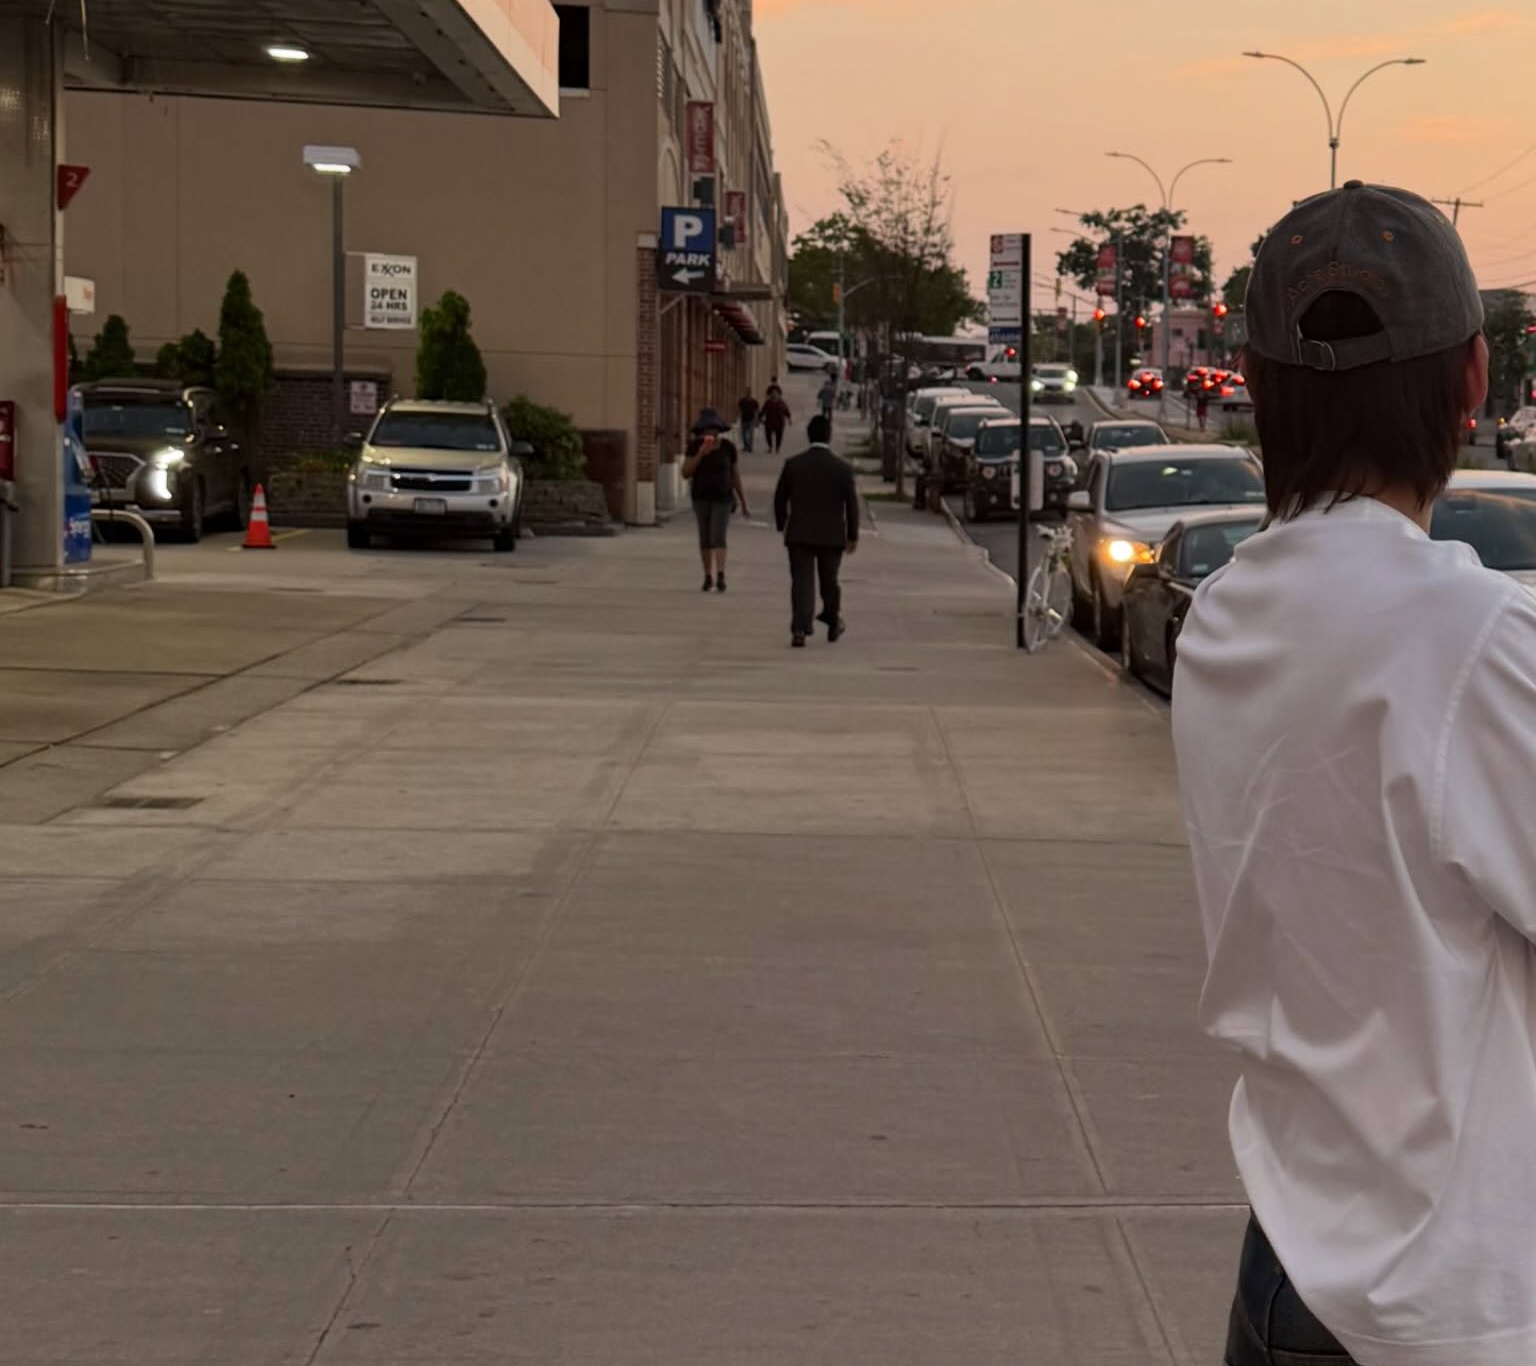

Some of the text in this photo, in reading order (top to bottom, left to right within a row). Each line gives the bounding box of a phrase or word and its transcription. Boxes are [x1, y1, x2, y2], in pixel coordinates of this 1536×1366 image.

[673, 214, 704, 249] P
[665, 252, 711, 267] PARK
[371, 262, 411, 277] EXXON
[371, 287, 407, 300] OPEN
[371, 300, 408, 311] 24 HRS
